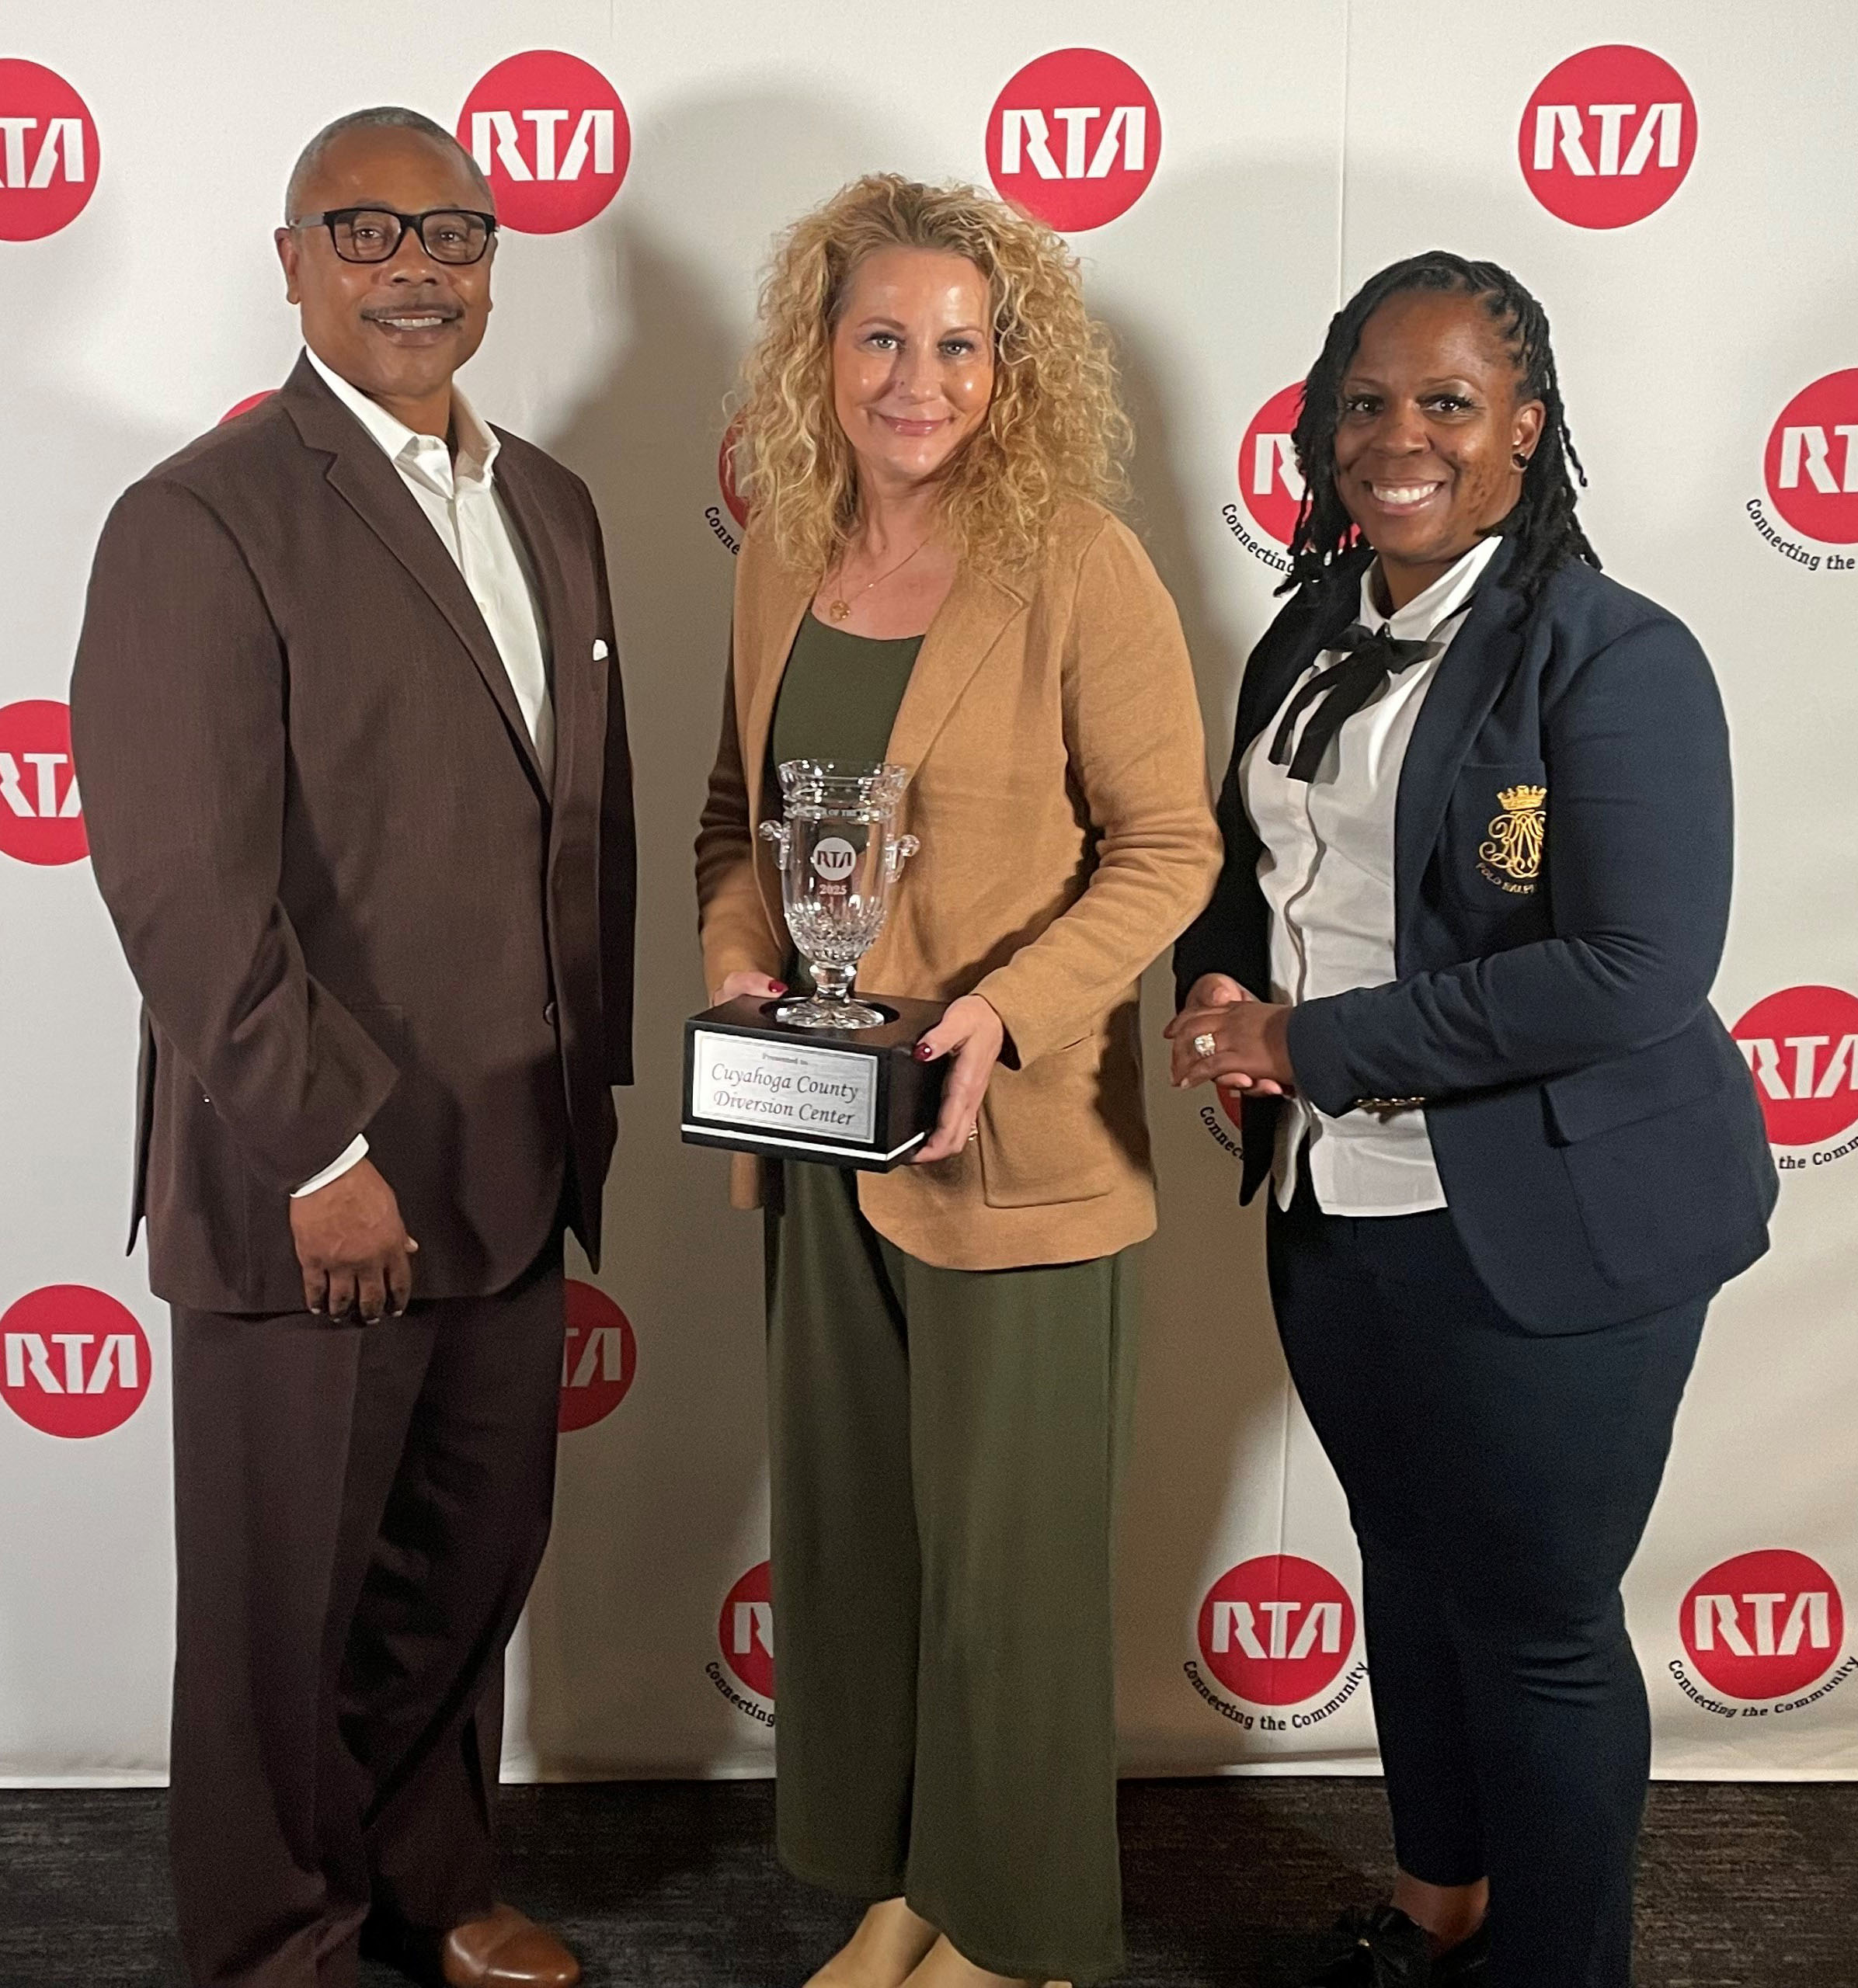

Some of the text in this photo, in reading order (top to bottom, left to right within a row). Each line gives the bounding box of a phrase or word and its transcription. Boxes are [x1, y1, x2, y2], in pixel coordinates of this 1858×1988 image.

[0, 118, 85, 188] TA
[471, 109, 614, 181] RTA
[1001, 106, 1146, 179] RTA
[1533, 103, 1682, 176] RTA
[1779, 425, 1858, 493] RT
[705, 506, 740, 555] Conne
[1746, 499, 1856, 571] Connecting the
[817, 850, 851, 868] RTA
[712, 1063, 858, 1103] Cuyahoga County
[1736, 1034, 1858, 1100] RTA
[714, 1091, 855, 1125] Diversion Center
[1200, 1107, 1244, 1160] Connec
[1779, 1156, 1806, 1169] the
[5, 1333, 138, 1393] RTA
[1212, 1601, 1342, 1659] RTA
[1695, 1592, 1830, 1656] RTA
[706, 1662, 774, 1727] Connecting
[1184, 1660, 1368, 1730] Connecting the Community
[1668, 1656, 1858, 1718] Connecting the Community
